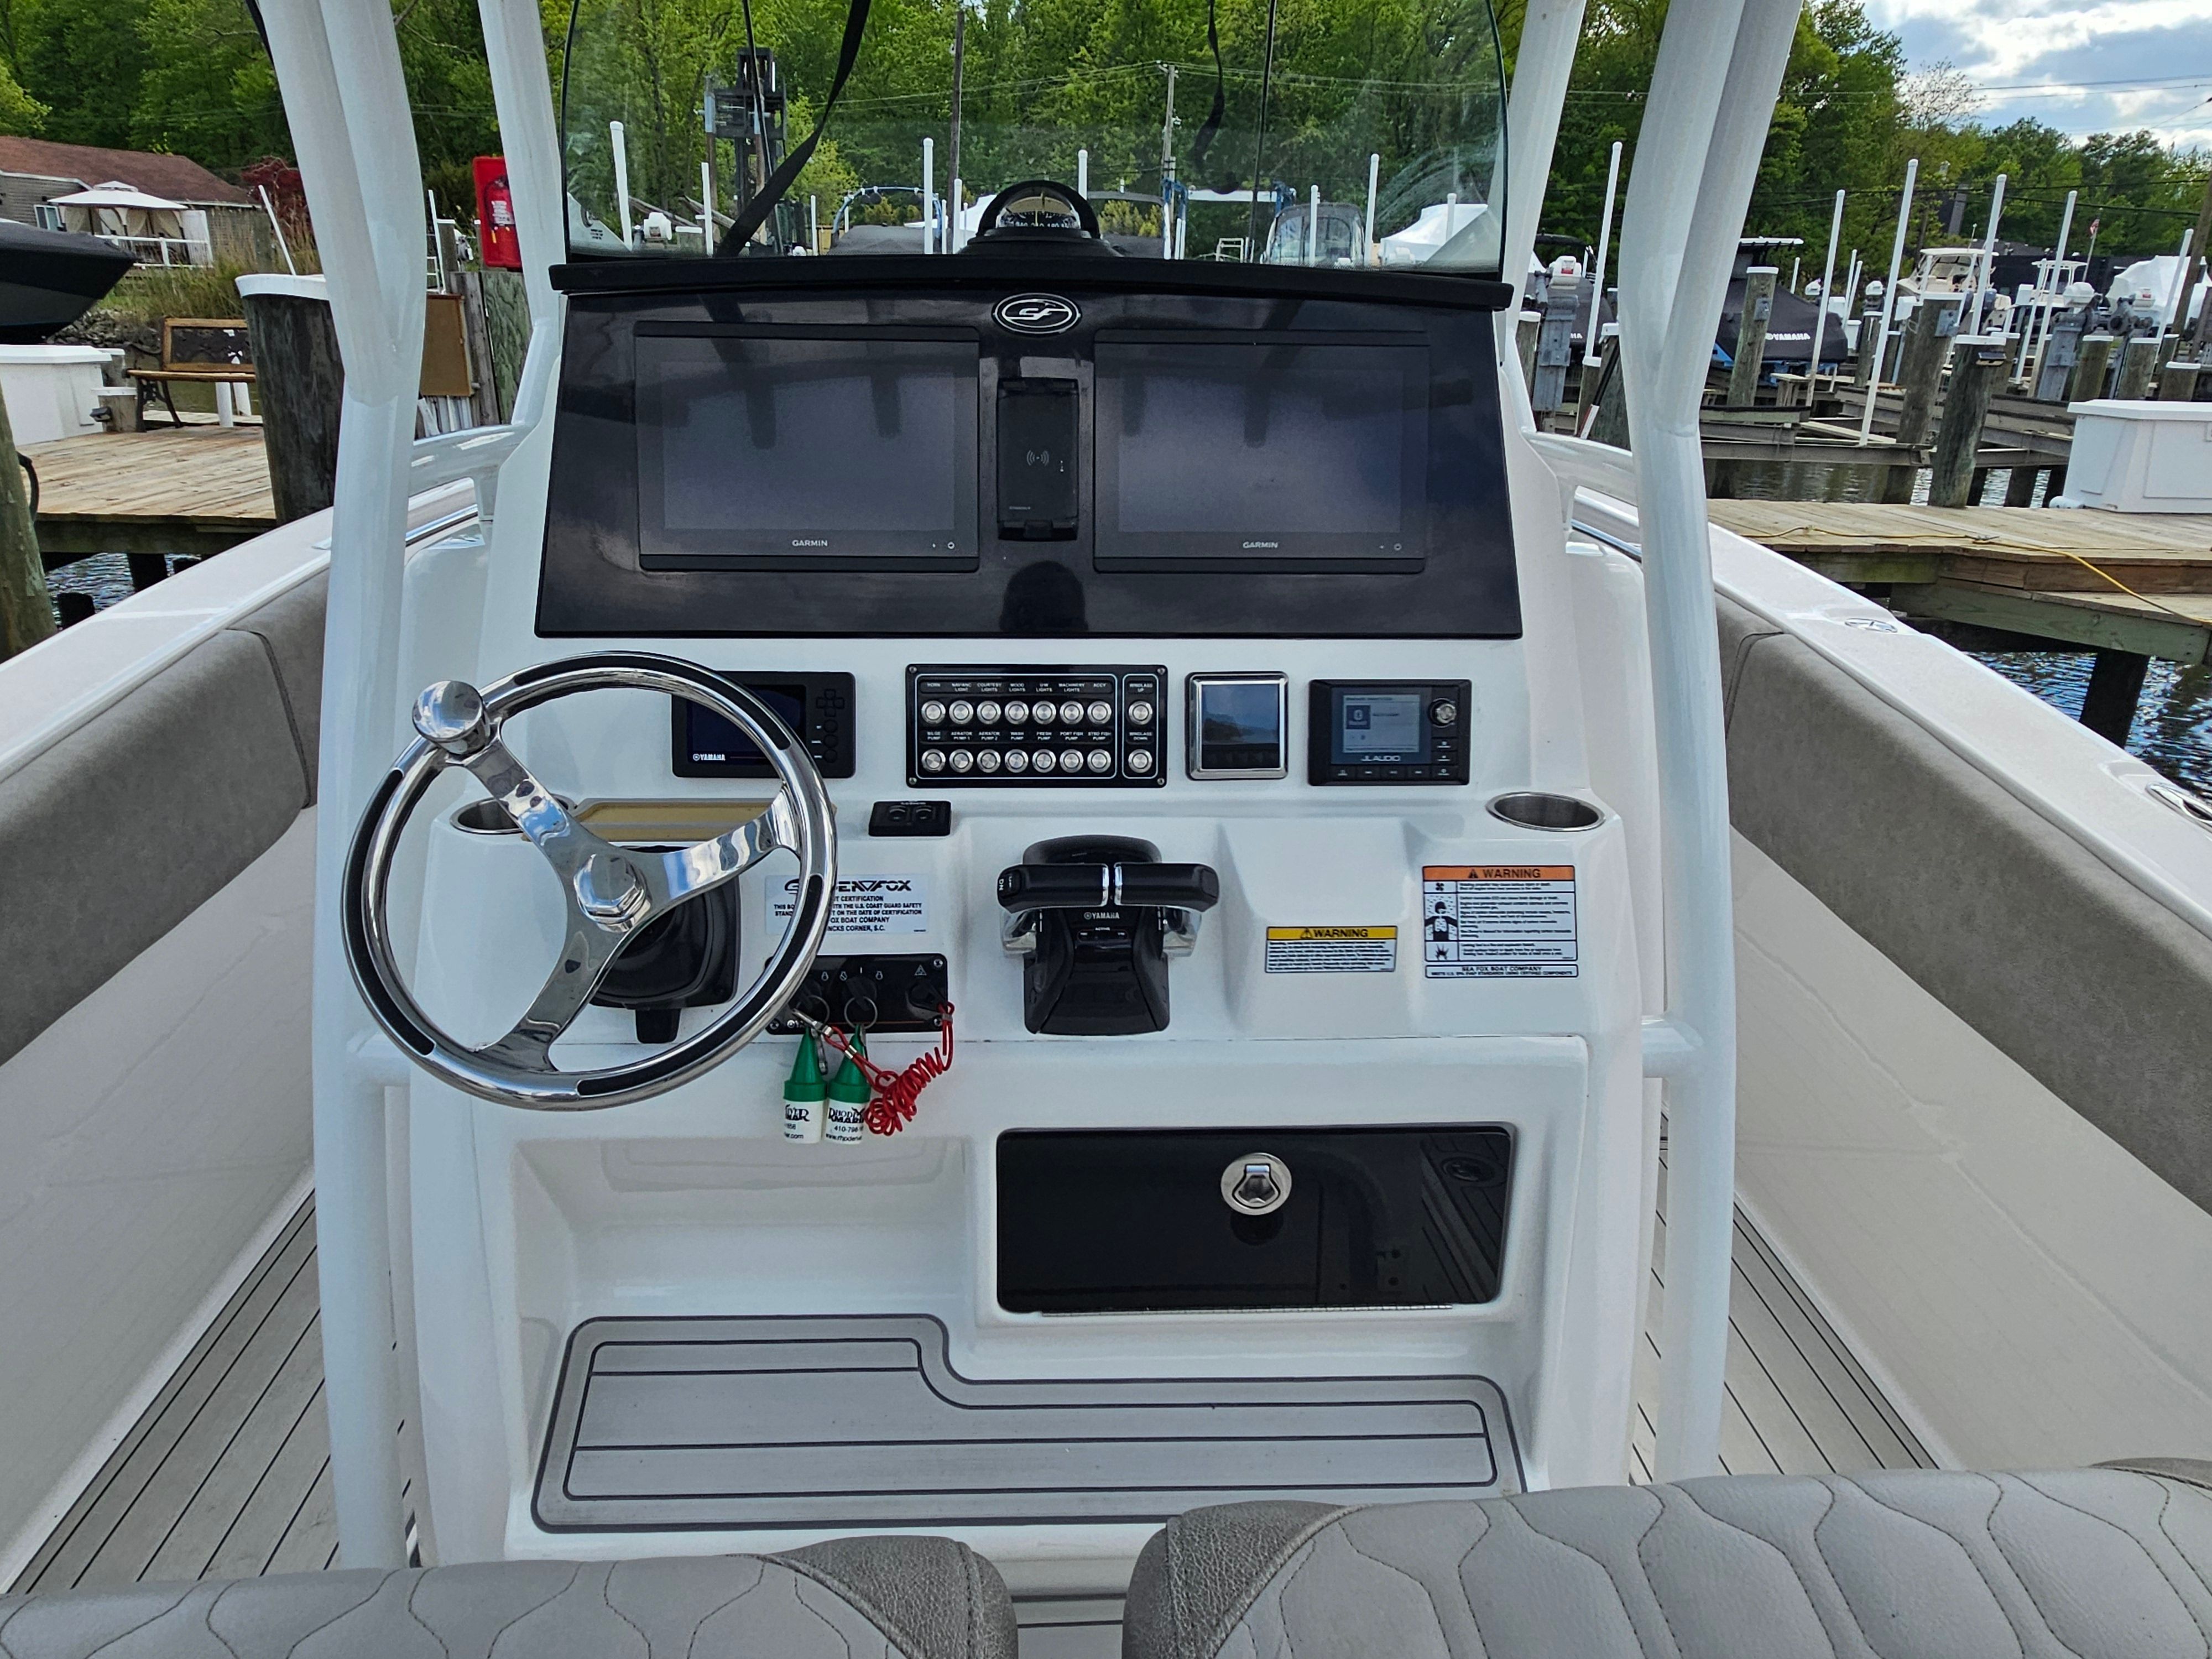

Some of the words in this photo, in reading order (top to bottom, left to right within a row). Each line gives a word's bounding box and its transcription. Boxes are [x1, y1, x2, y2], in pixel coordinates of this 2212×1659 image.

[1483, 869, 1541, 878] WARNING
[1092, 911, 1120, 920] YAMAHA
[1313, 928, 1368, 937] WARNING
